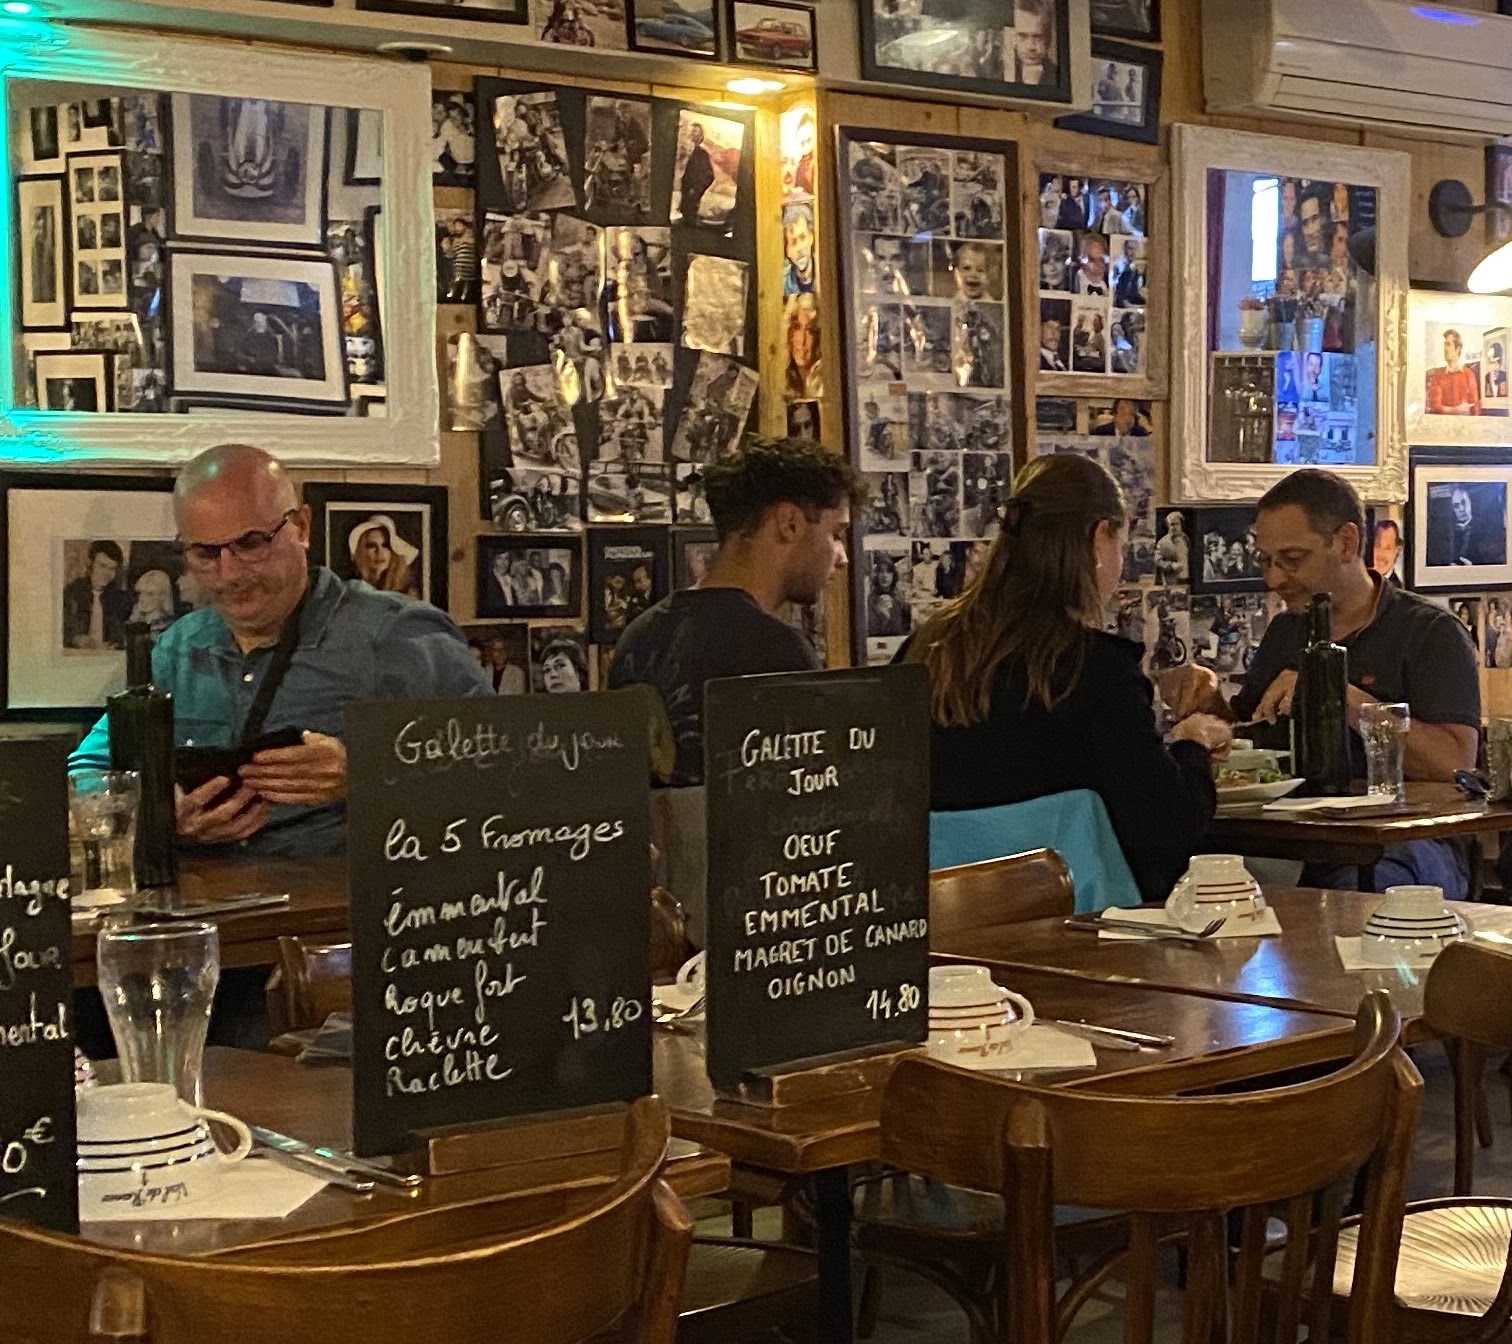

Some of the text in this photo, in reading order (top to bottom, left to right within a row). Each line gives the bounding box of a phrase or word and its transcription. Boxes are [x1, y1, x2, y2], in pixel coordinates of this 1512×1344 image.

[741, 727, 876, 768] GALETTE DU
[786, 765, 840, 796] JOUR
[440, 818, 468, 852] 5
[481, 814, 624, 861] Fromages
[783, 829, 842, 860] OEUF
[759, 861, 854, 900] TOMATE
[745, 888, 885, 936] EMMENTAL
[733, 918, 928, 973] MAGRET DE CANARD
[767, 964, 856, 999] OIGNON
[386, 1049, 513, 1097] Raclette
